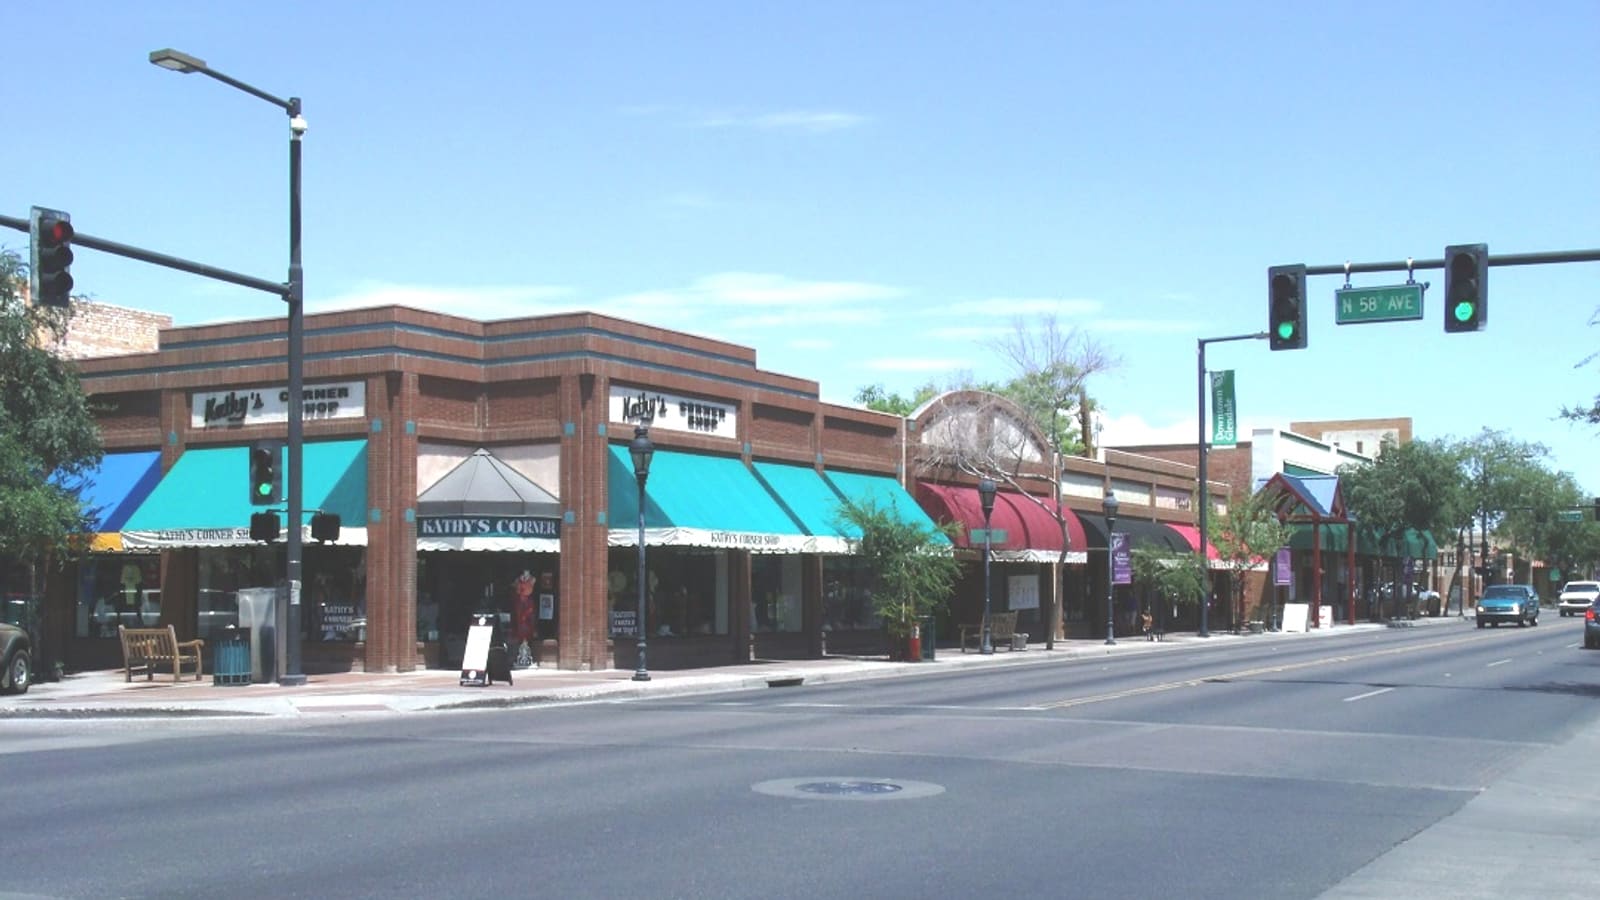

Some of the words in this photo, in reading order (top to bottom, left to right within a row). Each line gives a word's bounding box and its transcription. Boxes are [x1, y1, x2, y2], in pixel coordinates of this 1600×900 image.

[1342, 298, 1352, 313] N
[1388, 294, 1414, 311] AVE
[204, 391, 264, 423] Kathy's
[279, 387, 349, 402] CRNER
[303, 401, 340, 414] HOP
[622, 392, 668, 422] Kathy's
[1215, 390, 1225, 441] Downtown
[1224, 399, 1234, 441] Glendale
[158, 528, 193, 541] KATHY'S
[196, 528, 234, 541] CORNER
[422, 519, 490, 534] KATHY'S
[496, 519, 556, 535] CORNER
[711, 532, 738, 543] KATHY'S
[739, 534, 763, 546] CORNER
